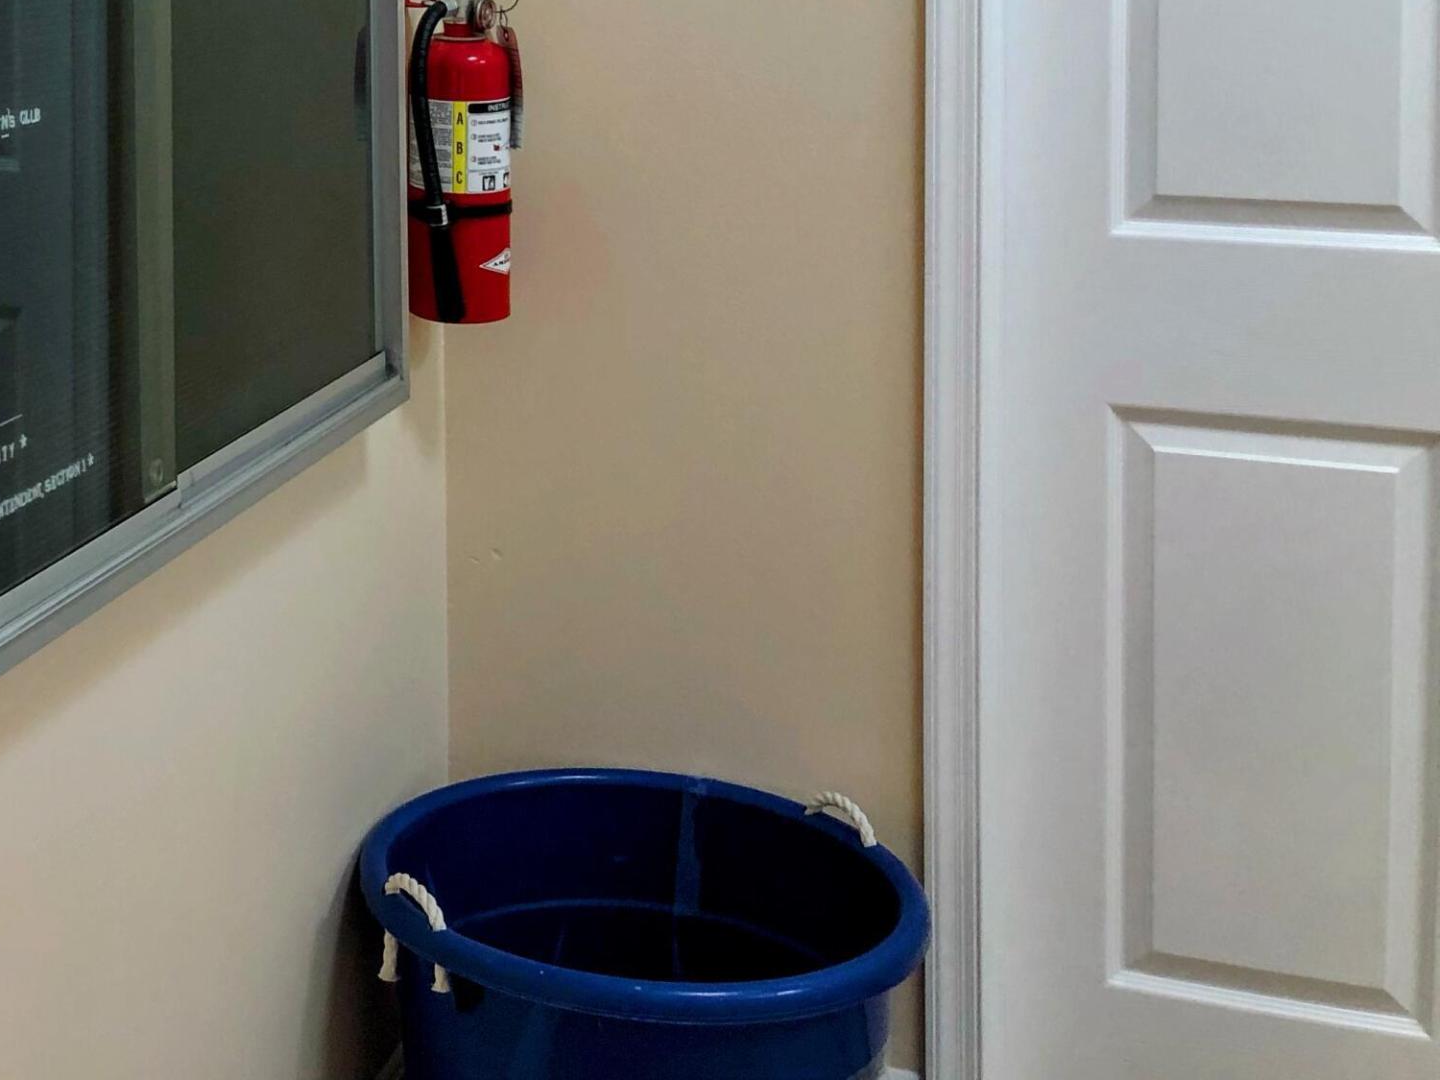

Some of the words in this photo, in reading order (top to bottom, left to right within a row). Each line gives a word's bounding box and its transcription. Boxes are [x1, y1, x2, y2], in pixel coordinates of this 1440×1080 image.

[19, 107, 41, 126] CLUB
[456, 112, 464, 125] A
[456, 142, 463, 155] B
[456, 171, 463, 184] C
